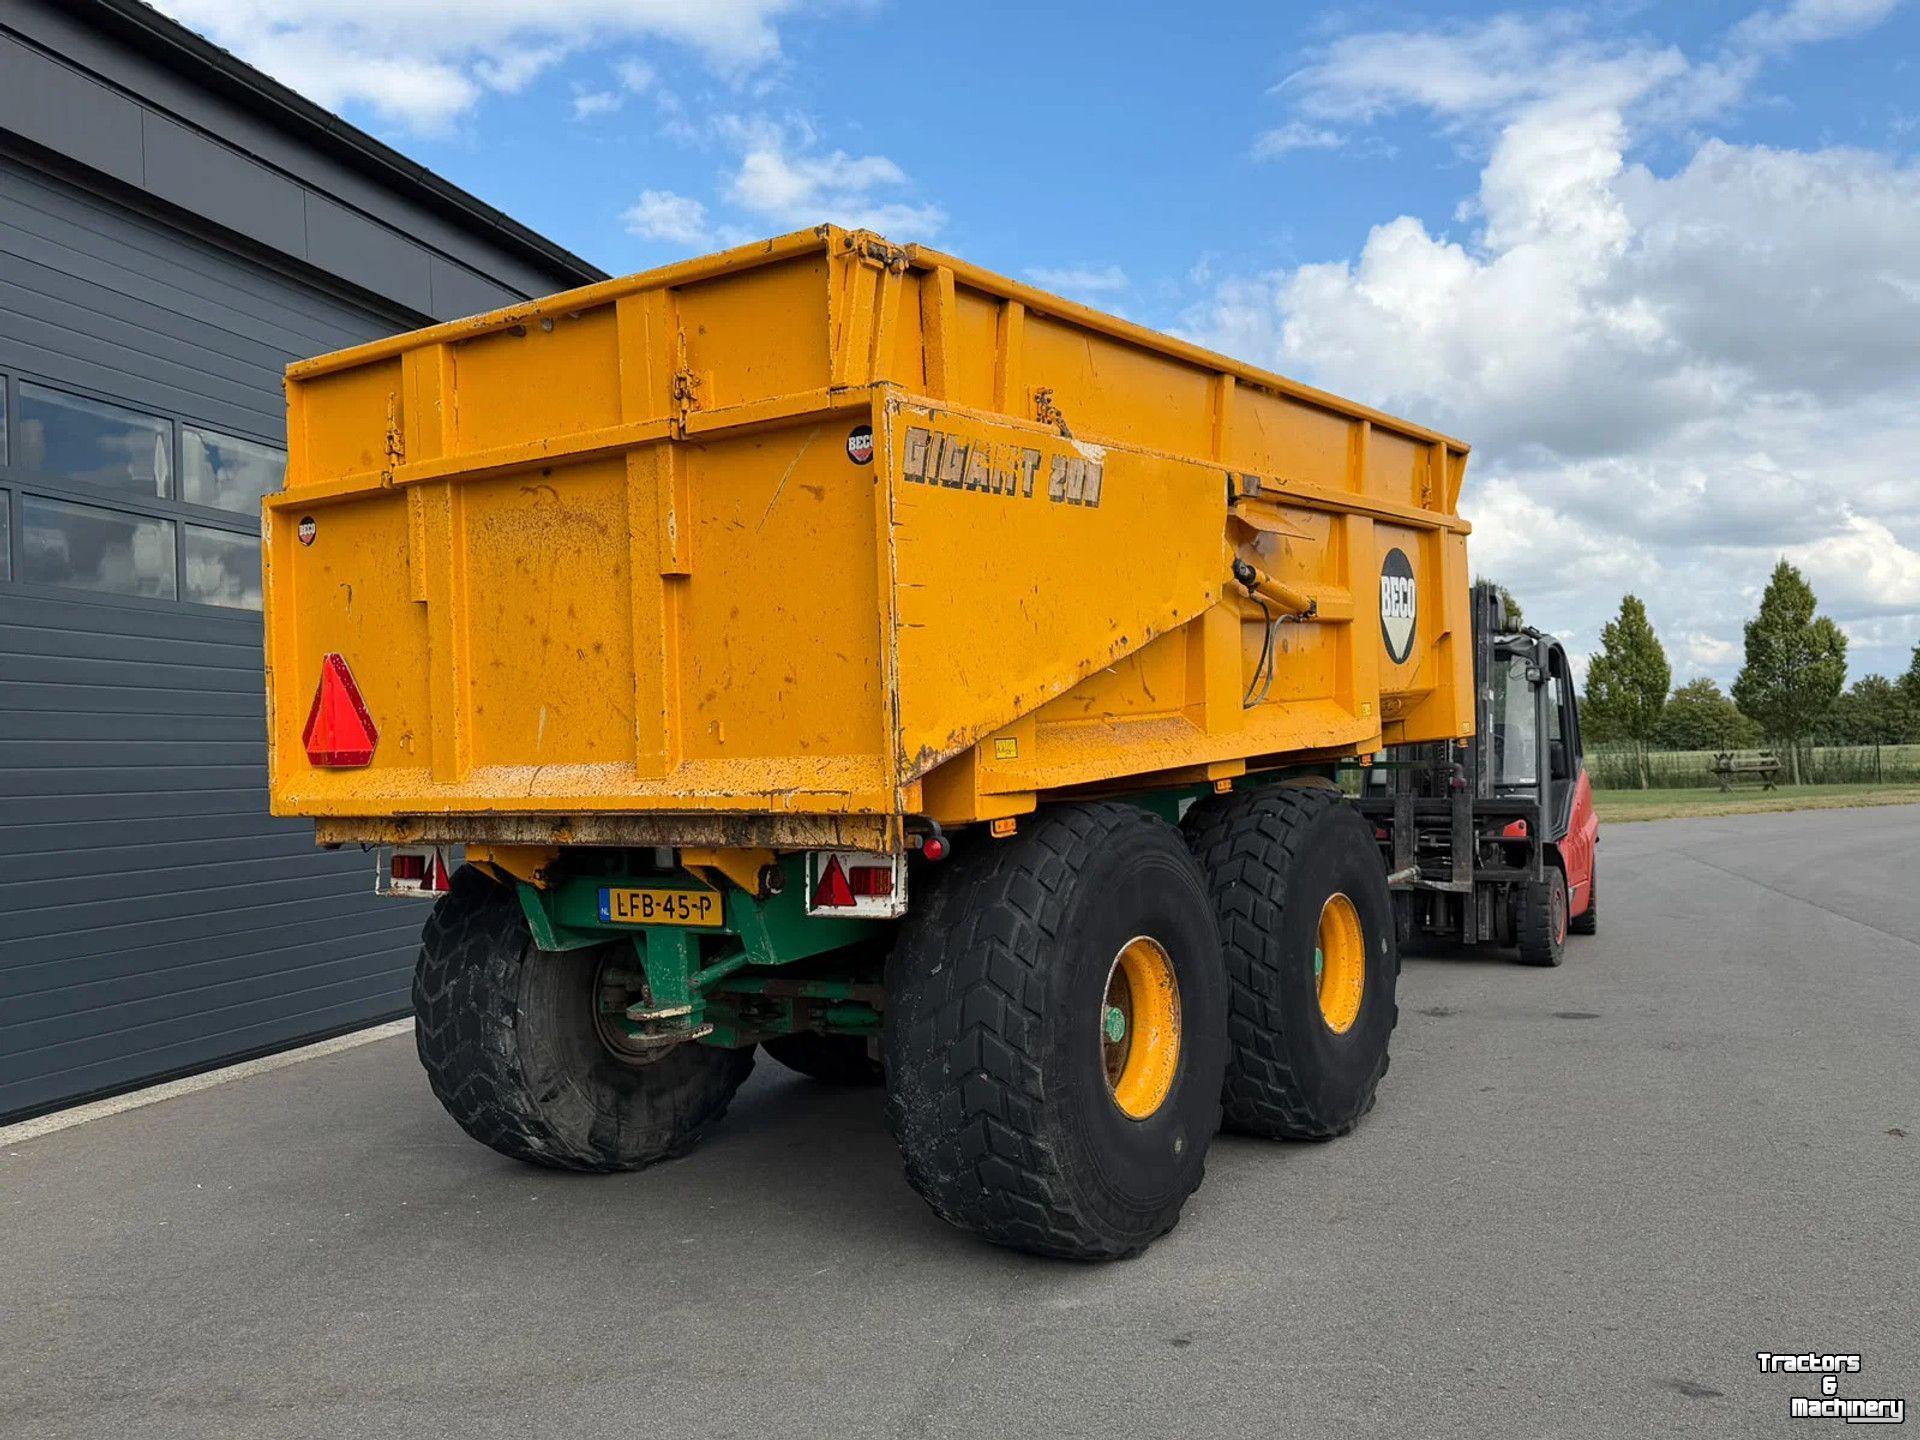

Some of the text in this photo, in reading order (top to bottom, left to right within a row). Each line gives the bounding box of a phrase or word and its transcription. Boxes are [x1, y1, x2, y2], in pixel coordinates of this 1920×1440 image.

[903, 426, 1042, 498] GIGANT
[1381, 576, 1416, 618] BECO
[617, 893, 711, 920] LFB-45-P
